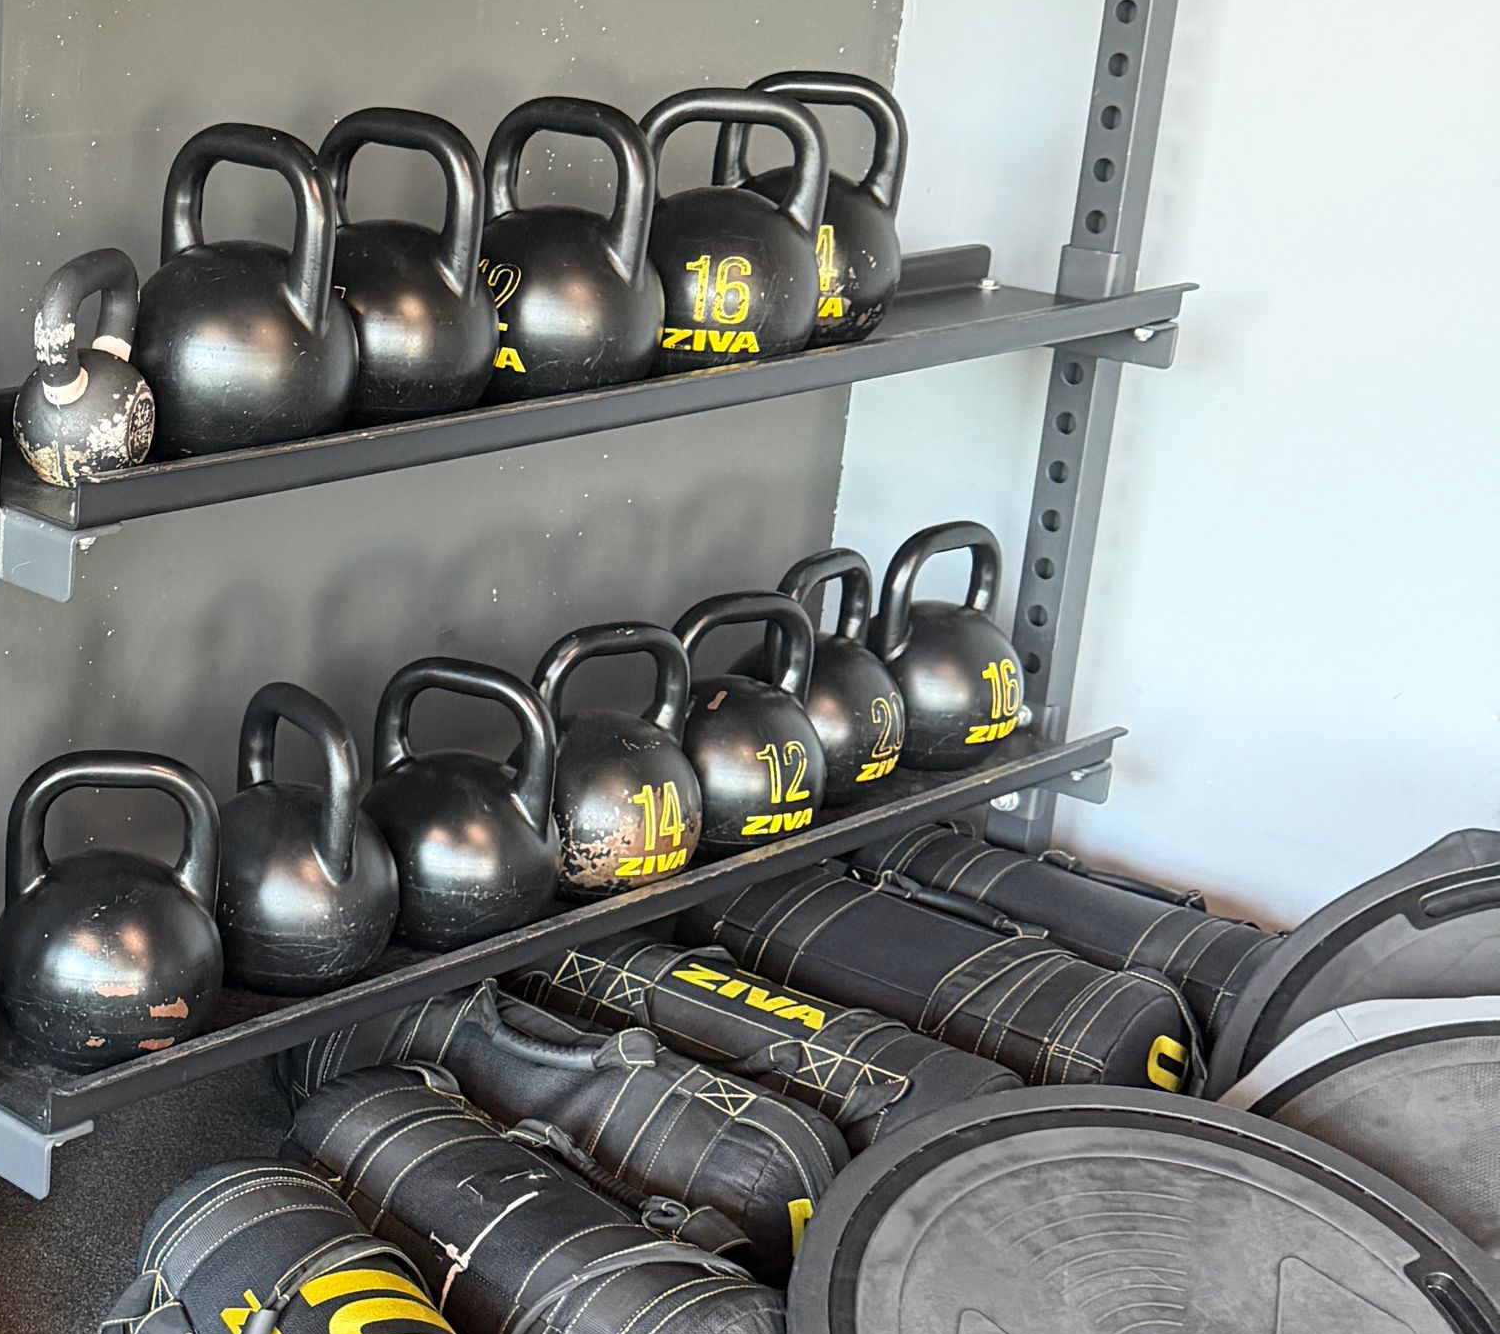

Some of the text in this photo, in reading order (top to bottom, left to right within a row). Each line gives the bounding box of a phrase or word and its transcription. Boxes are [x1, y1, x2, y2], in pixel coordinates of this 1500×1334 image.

[815, 224, 835, 292] 4
[687, 255, 752, 325] 16
[662, 328, 760, 353] ZIVA
[982, 658, 1020, 719] 16
[756, 741, 810, 804] 12
[632, 781, 685, 851] 14
[741, 807, 813, 836] ZIVA
[614, 848, 688, 877] ZIVA
[672, 963, 827, 1030] ZIVA
